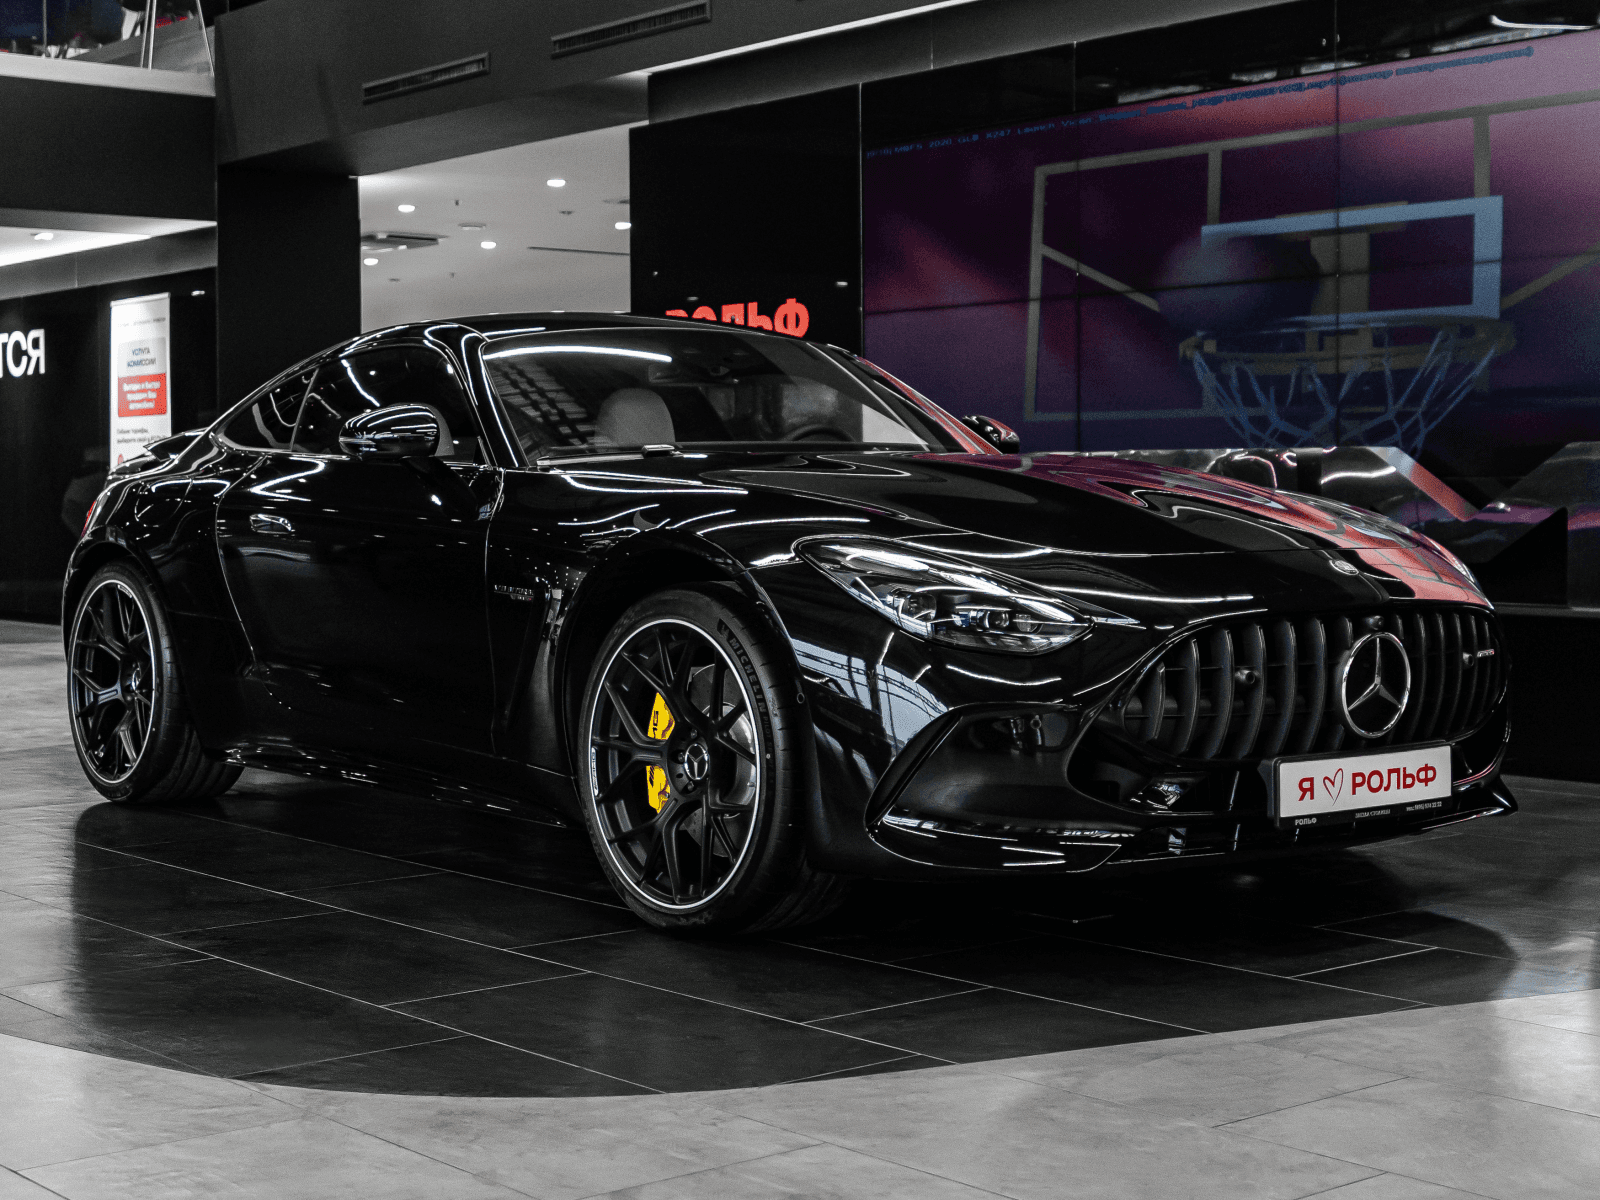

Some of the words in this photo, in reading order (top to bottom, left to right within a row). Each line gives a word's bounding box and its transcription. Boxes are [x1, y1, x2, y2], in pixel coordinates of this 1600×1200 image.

[729, 637, 767, 713] MICHELIN
[1298, 777, 1314, 801] Я
[1351, 764, 1437, 795] РОЛЬФ
[1294, 817, 1317, 826] РОЛЬФ
